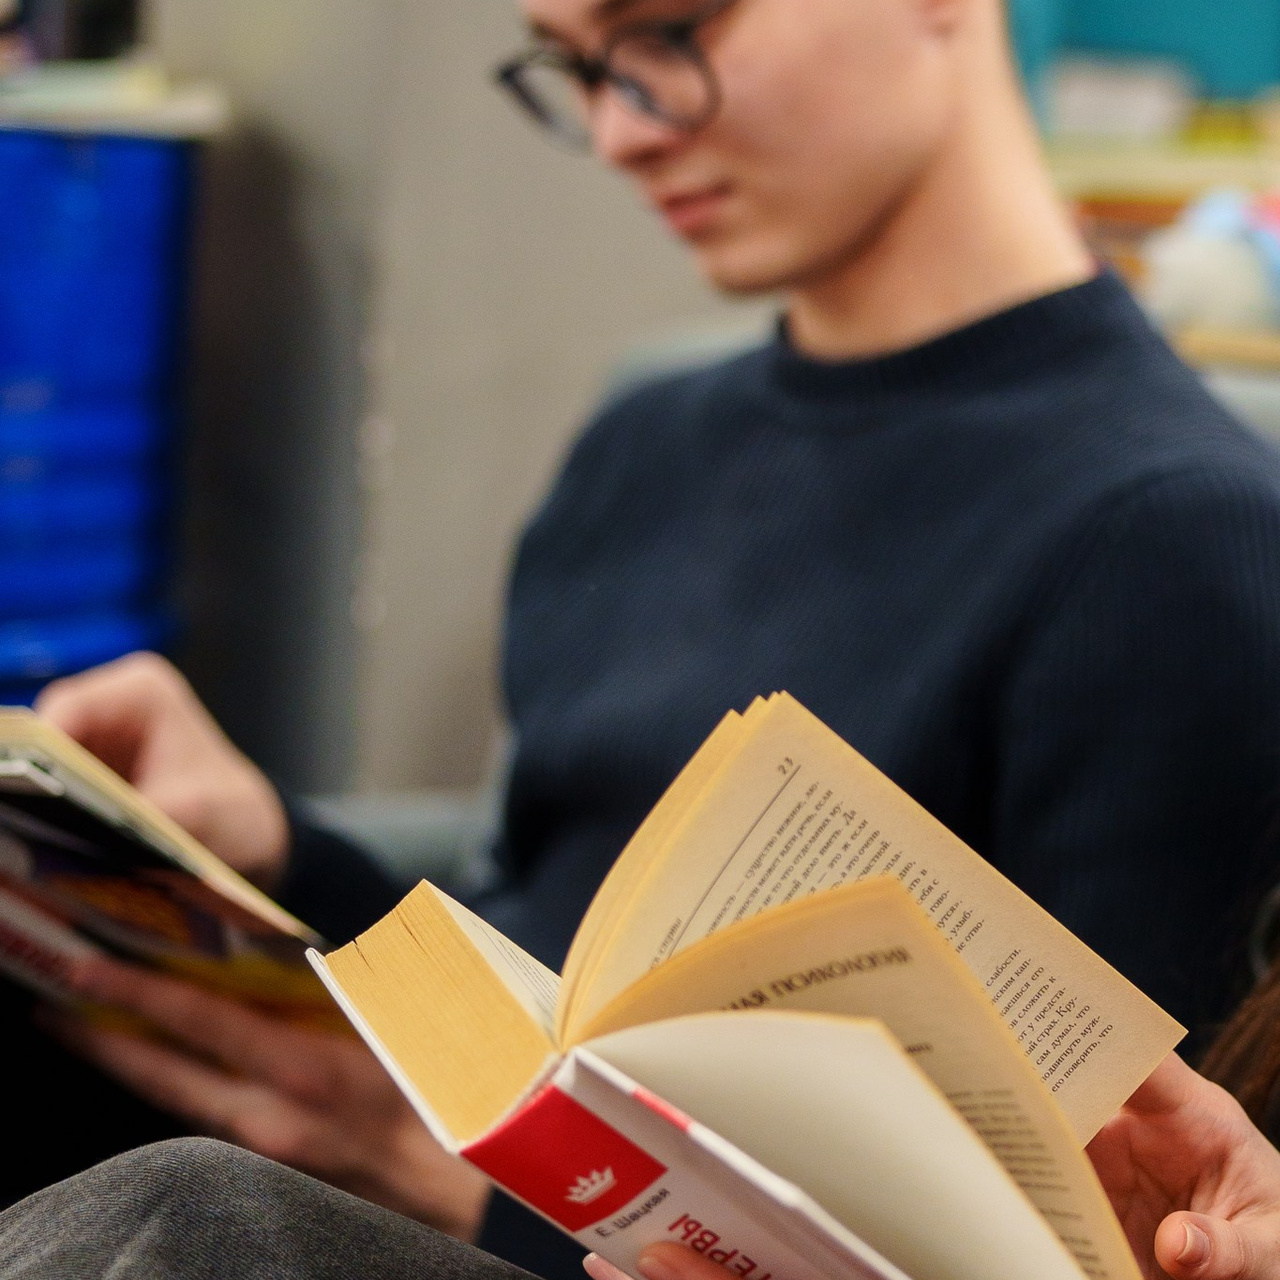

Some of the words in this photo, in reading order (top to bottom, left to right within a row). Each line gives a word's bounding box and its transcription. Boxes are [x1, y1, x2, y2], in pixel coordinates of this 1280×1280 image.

[777, 756, 793, 775] 23
[757, 857, 780, 886] может
[779, 834, 798, 857] идти
[814, 789, 833, 811] если
[771, 881, 782, 893] то
[780, 864, 794, 881] что
[793, 817, 831, 864] отдельных
[829, 801, 842, 817] му-
[801, 857, 818, 879] дело
[842, 809, 856, 825] Да
[827, 852, 841, 868] это
[850, 819, 868, 840] если
[845, 855, 859, 870] это
[858, 830, 880, 855] очень
[929, 890, 949, 912] гово-
[950, 909, 972, 936] улыб-
[964, 919, 984, 941] отво-
[986, 949, 1021, 986] слабости.
[1014, 958, 1031, 976] кап-
[1030, 966, 1044, 981] его
[1017, 984, 1049, 1018] сложить
[1034, 987, 1066, 1022] предста-
[1036, 1019, 1059, 1042] страх.
[1055, 996, 1077, 1017] Кру-
[1035, 1049, 1050, 1065] сам
[1050, 1022, 1076, 1049] думал,
[1075, 1005, 1090, 1018] что
[1080, 1015, 1100, 1037] муж-
[1051, 1078, 1064, 1092] его
[1063, 1041, 1100, 1078] поверить,
[1098, 1024, 1113, 1037] что
